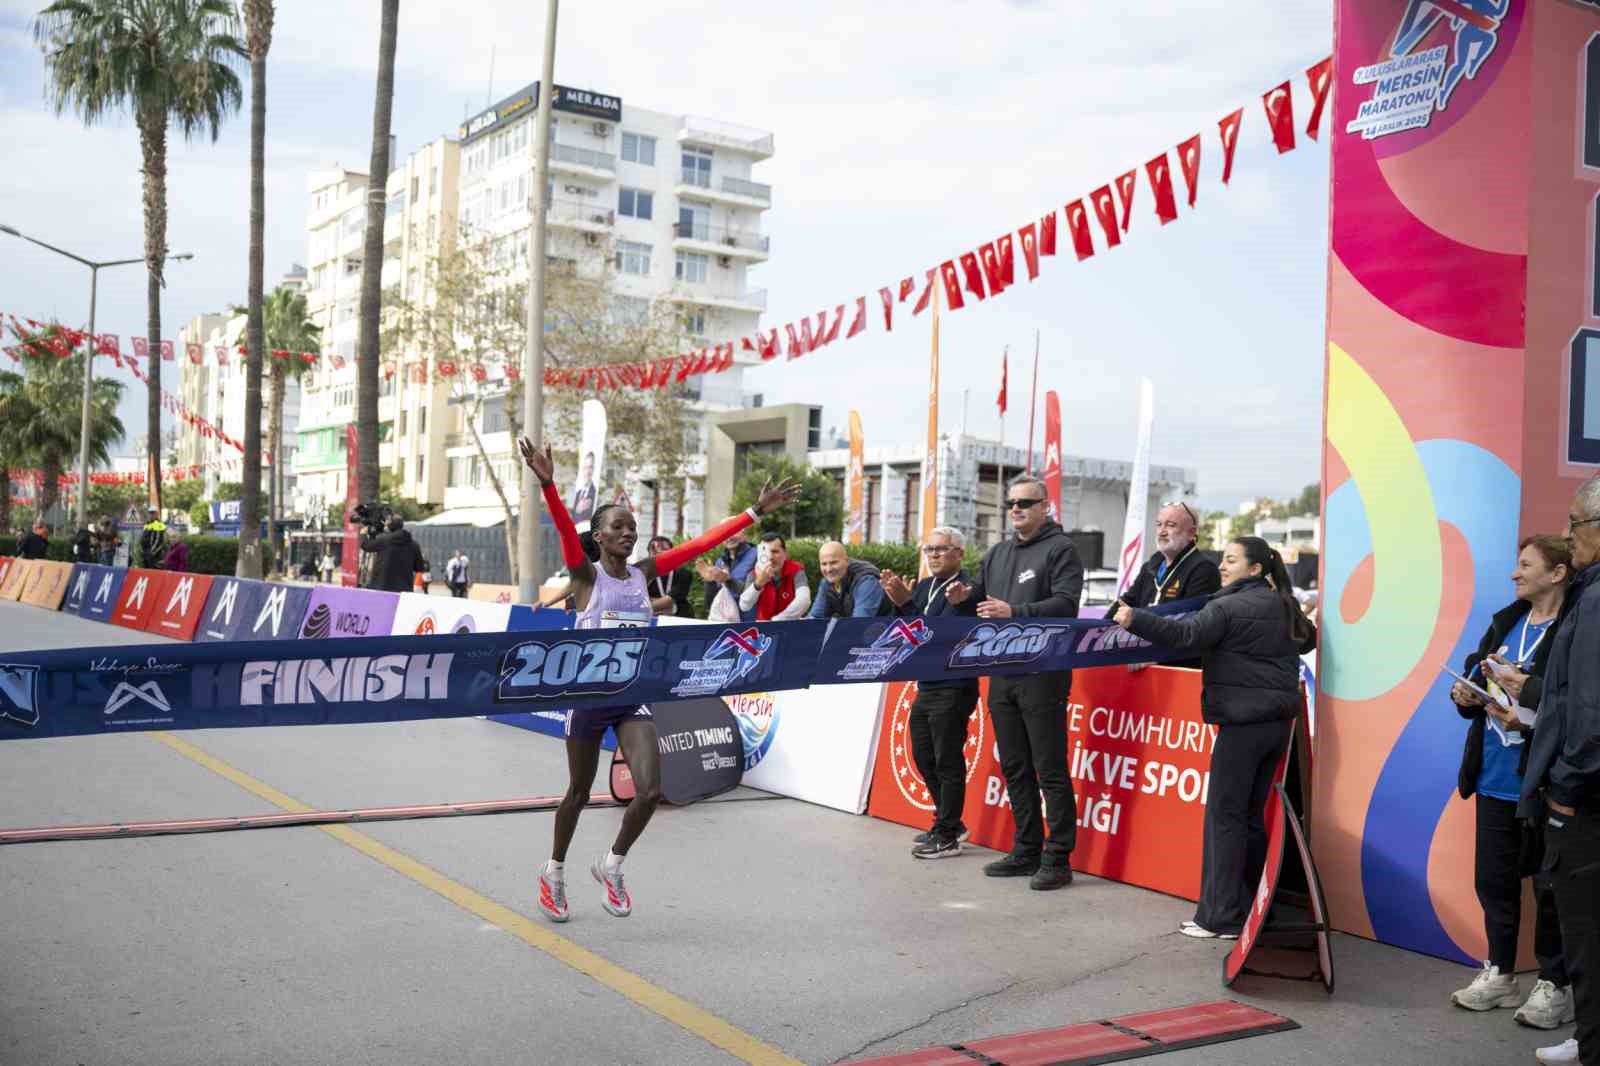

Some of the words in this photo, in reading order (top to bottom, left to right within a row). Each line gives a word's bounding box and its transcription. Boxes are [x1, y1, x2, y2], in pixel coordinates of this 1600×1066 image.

[1377, 63, 1442, 97] MERSİN
[566, 91, 620, 110] MERADA
[1360, 87, 1436, 117] MARATONU
[1404, 114, 1428, 126] 2025
[336, 612, 369, 636] WORLD
[240, 653, 454, 706] FINISH
[508, 641, 643, 689] 2025
[658, 731, 695, 754] NITED
[694, 727, 733, 748] TIMING
[1103, 752, 1138, 791] VE
